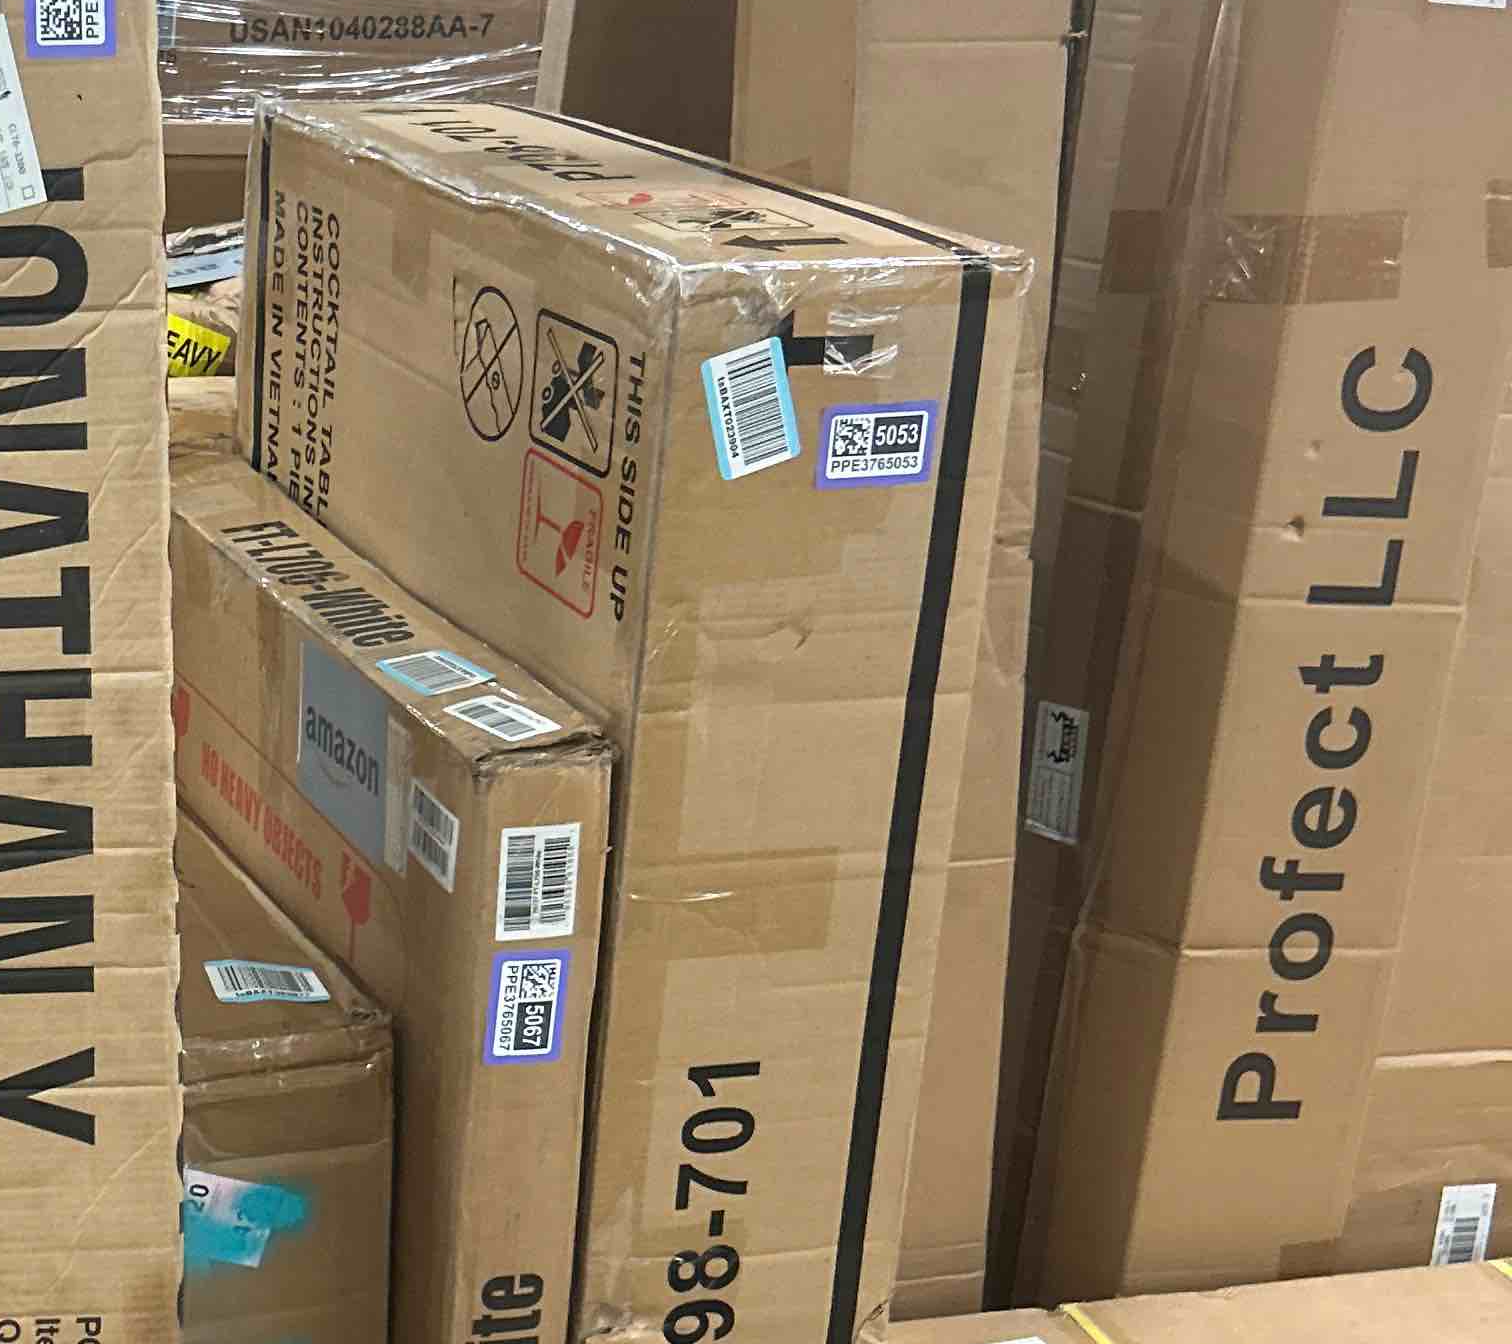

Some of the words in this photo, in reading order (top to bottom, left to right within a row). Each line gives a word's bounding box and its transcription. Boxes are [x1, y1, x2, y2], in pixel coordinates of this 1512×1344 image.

[270, 189, 285, 292] MADE
[270, 302, 284, 337] IN
[293, 200, 310, 389] CONTENTS
[305, 205, 324, 466] INSTRUCTIONS
[322, 213, 341, 409] COCKTAIL
[167, 330, 222, 373] EAVY
[624, 351, 647, 446] THIS
[287, 447, 301, 506] PIE
[831, 456, 919, 474] PPE3765053
[873, 423, 919, 447] 5053
[614, 456, 640, 555] SIDE
[220, 520, 415, 650] FT-L706-White
[609, 565, 629, 623] UP
[304, 704, 381, 799] amazon
[1216, 653, 1384, 1123] Profect
[1307, 345, 1433, 607] LLC
[219, 754, 262, 831] HEAVY
[263, 808, 324, 900] OBJECTS
[499, 965, 520, 1051] PPE3765067
[522, 1004, 545, 1047] 5067
